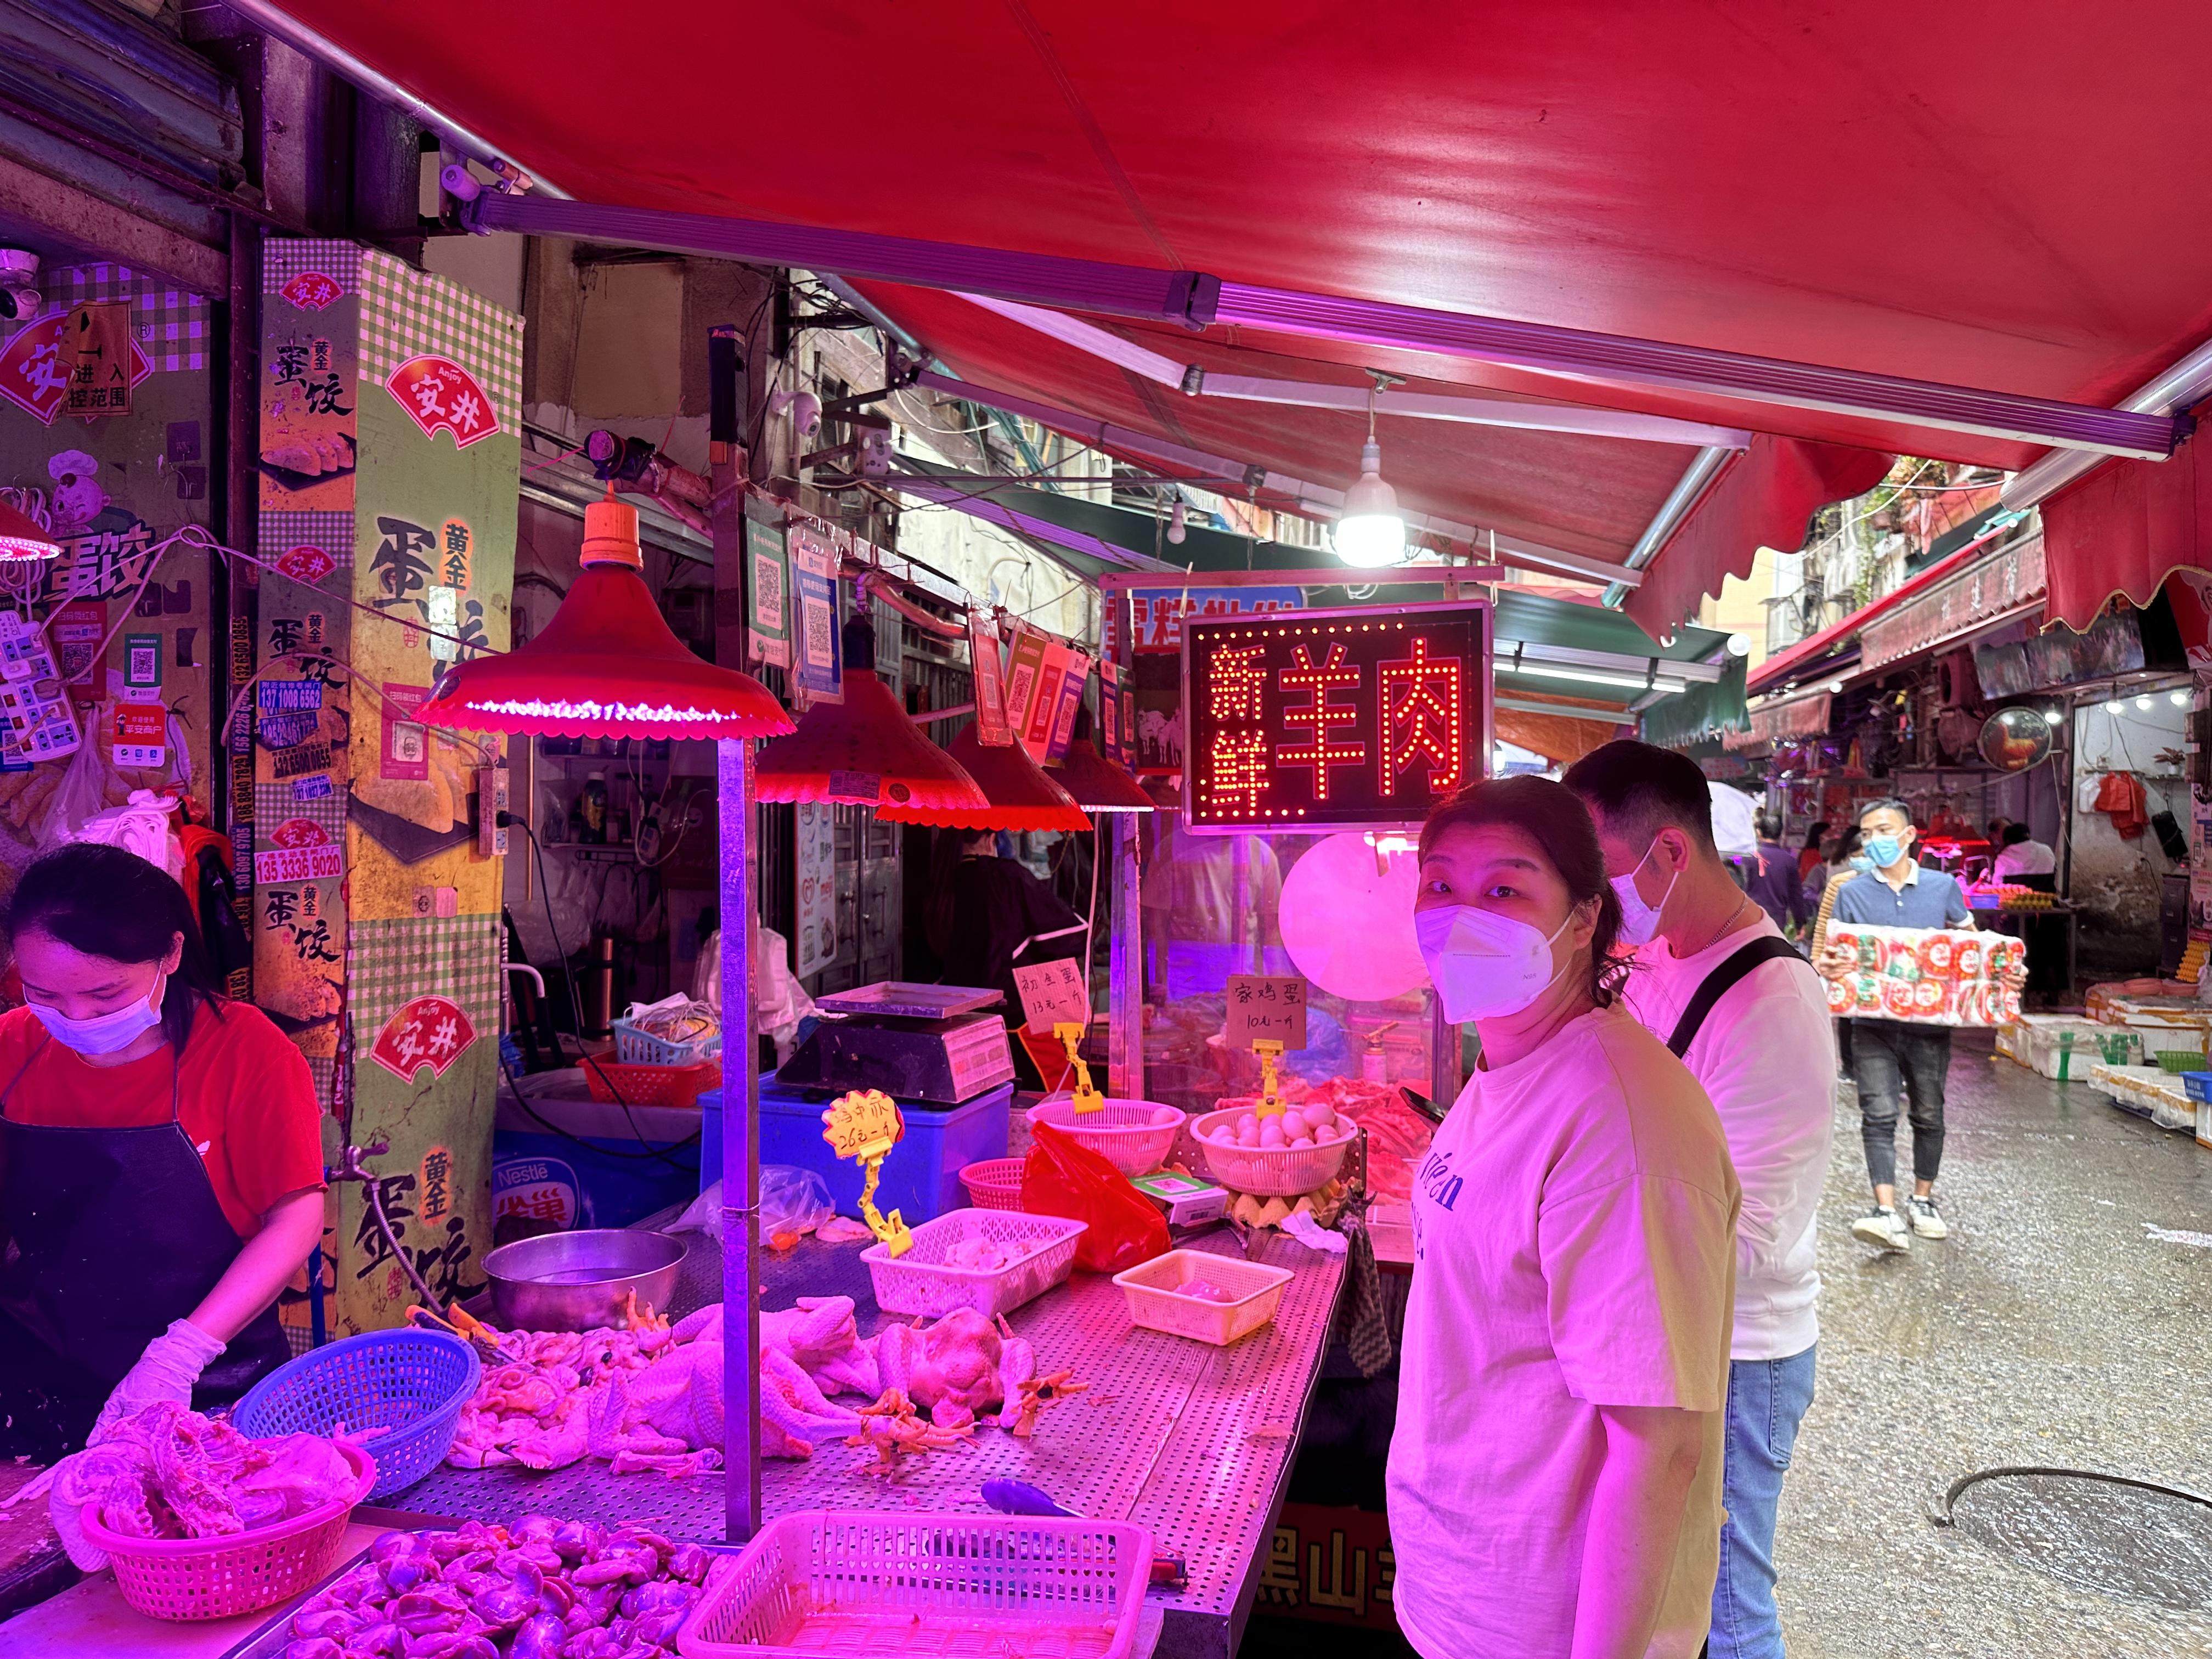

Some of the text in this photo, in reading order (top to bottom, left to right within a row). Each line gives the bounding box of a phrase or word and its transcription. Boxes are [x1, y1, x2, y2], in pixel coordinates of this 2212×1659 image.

[292, 283, 331, 302] 安井
[314, 341, 328, 370] 黄金
[274, 345, 354, 416] 蛋饺
[438, 366, 462, 384] Anjoy
[64, 386, 126, 408] 控范围
[410, 373, 479, 433] 安井
[43, 523, 151, 601] 蛋饺
[445, 523, 468, 591] 黄金
[308, 614, 322, 644] 黄金
[232, 617, 251, 681] 132 6500 0855
[268, 619, 347, 690] 蛋饺
[262, 688, 320, 708] 137 1008 6562
[126, 725, 162, 734] 平安商户
[235, 713, 250, 735] 2226
[1210, 644, 1270, 808] 新鲜
[1276, 637, 1462, 799] 羊肉
[235, 736, 250, 752] 156
[234, 758, 255, 822] 186 8840 7829
[235, 827, 250, 890] 130 6097 9705
[257, 854, 340, 882] 135 3336 9020
[303, 887, 317, 916] 黄金
[264, 891, 341, 962] 蛋饺
[1022, 967, 1076, 994] 初生蛋
[1234, 982, 1301, 1005] 家鸡蛋
[417, 1001, 440, 1016] Anjoy
[1032, 990, 1082, 1014] 13元一斤
[1247, 1014, 1293, 1029] 10元一斤
[392, 1016, 458, 1067] 安井
[425, 1152, 447, 1220] 黄金
[353, 1173, 488, 1310] 蛋饺
